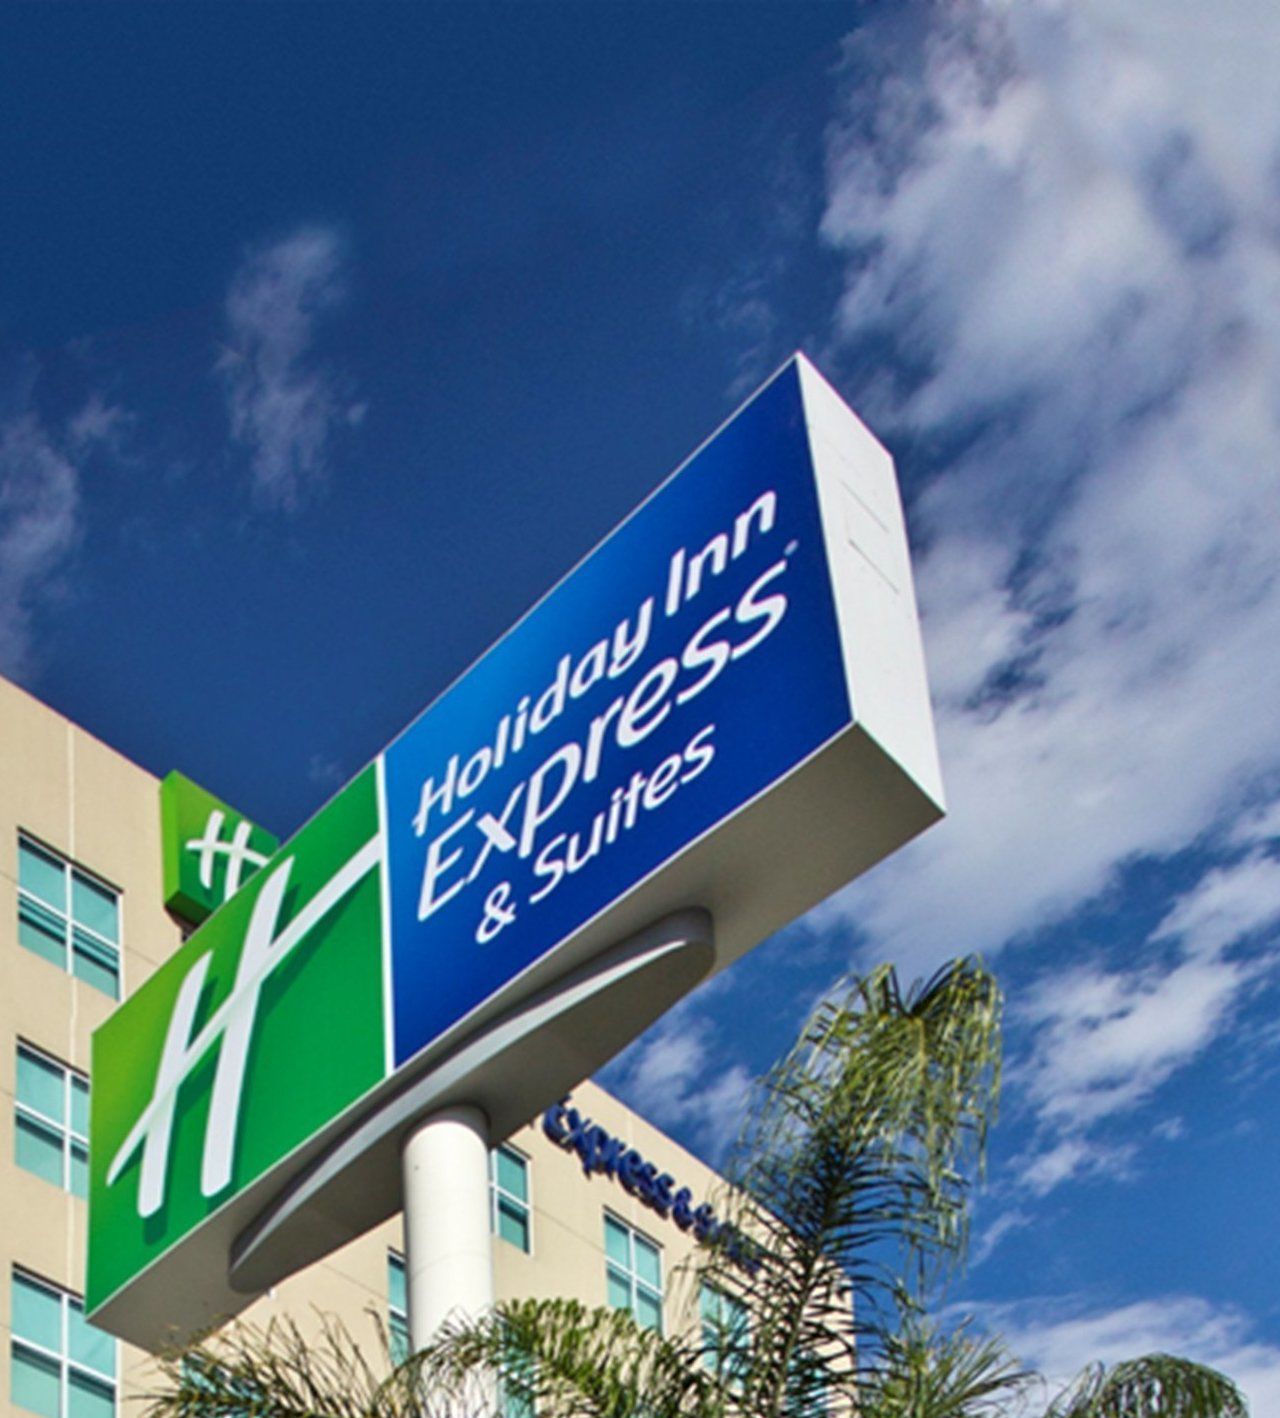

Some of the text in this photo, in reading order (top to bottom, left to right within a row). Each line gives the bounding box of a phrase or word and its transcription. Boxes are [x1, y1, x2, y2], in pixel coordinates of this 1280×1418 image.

[412, 491, 778, 838] Holiday Inn
[417, 559, 788, 922] Express
[476, 725, 715, 944] & Suites
